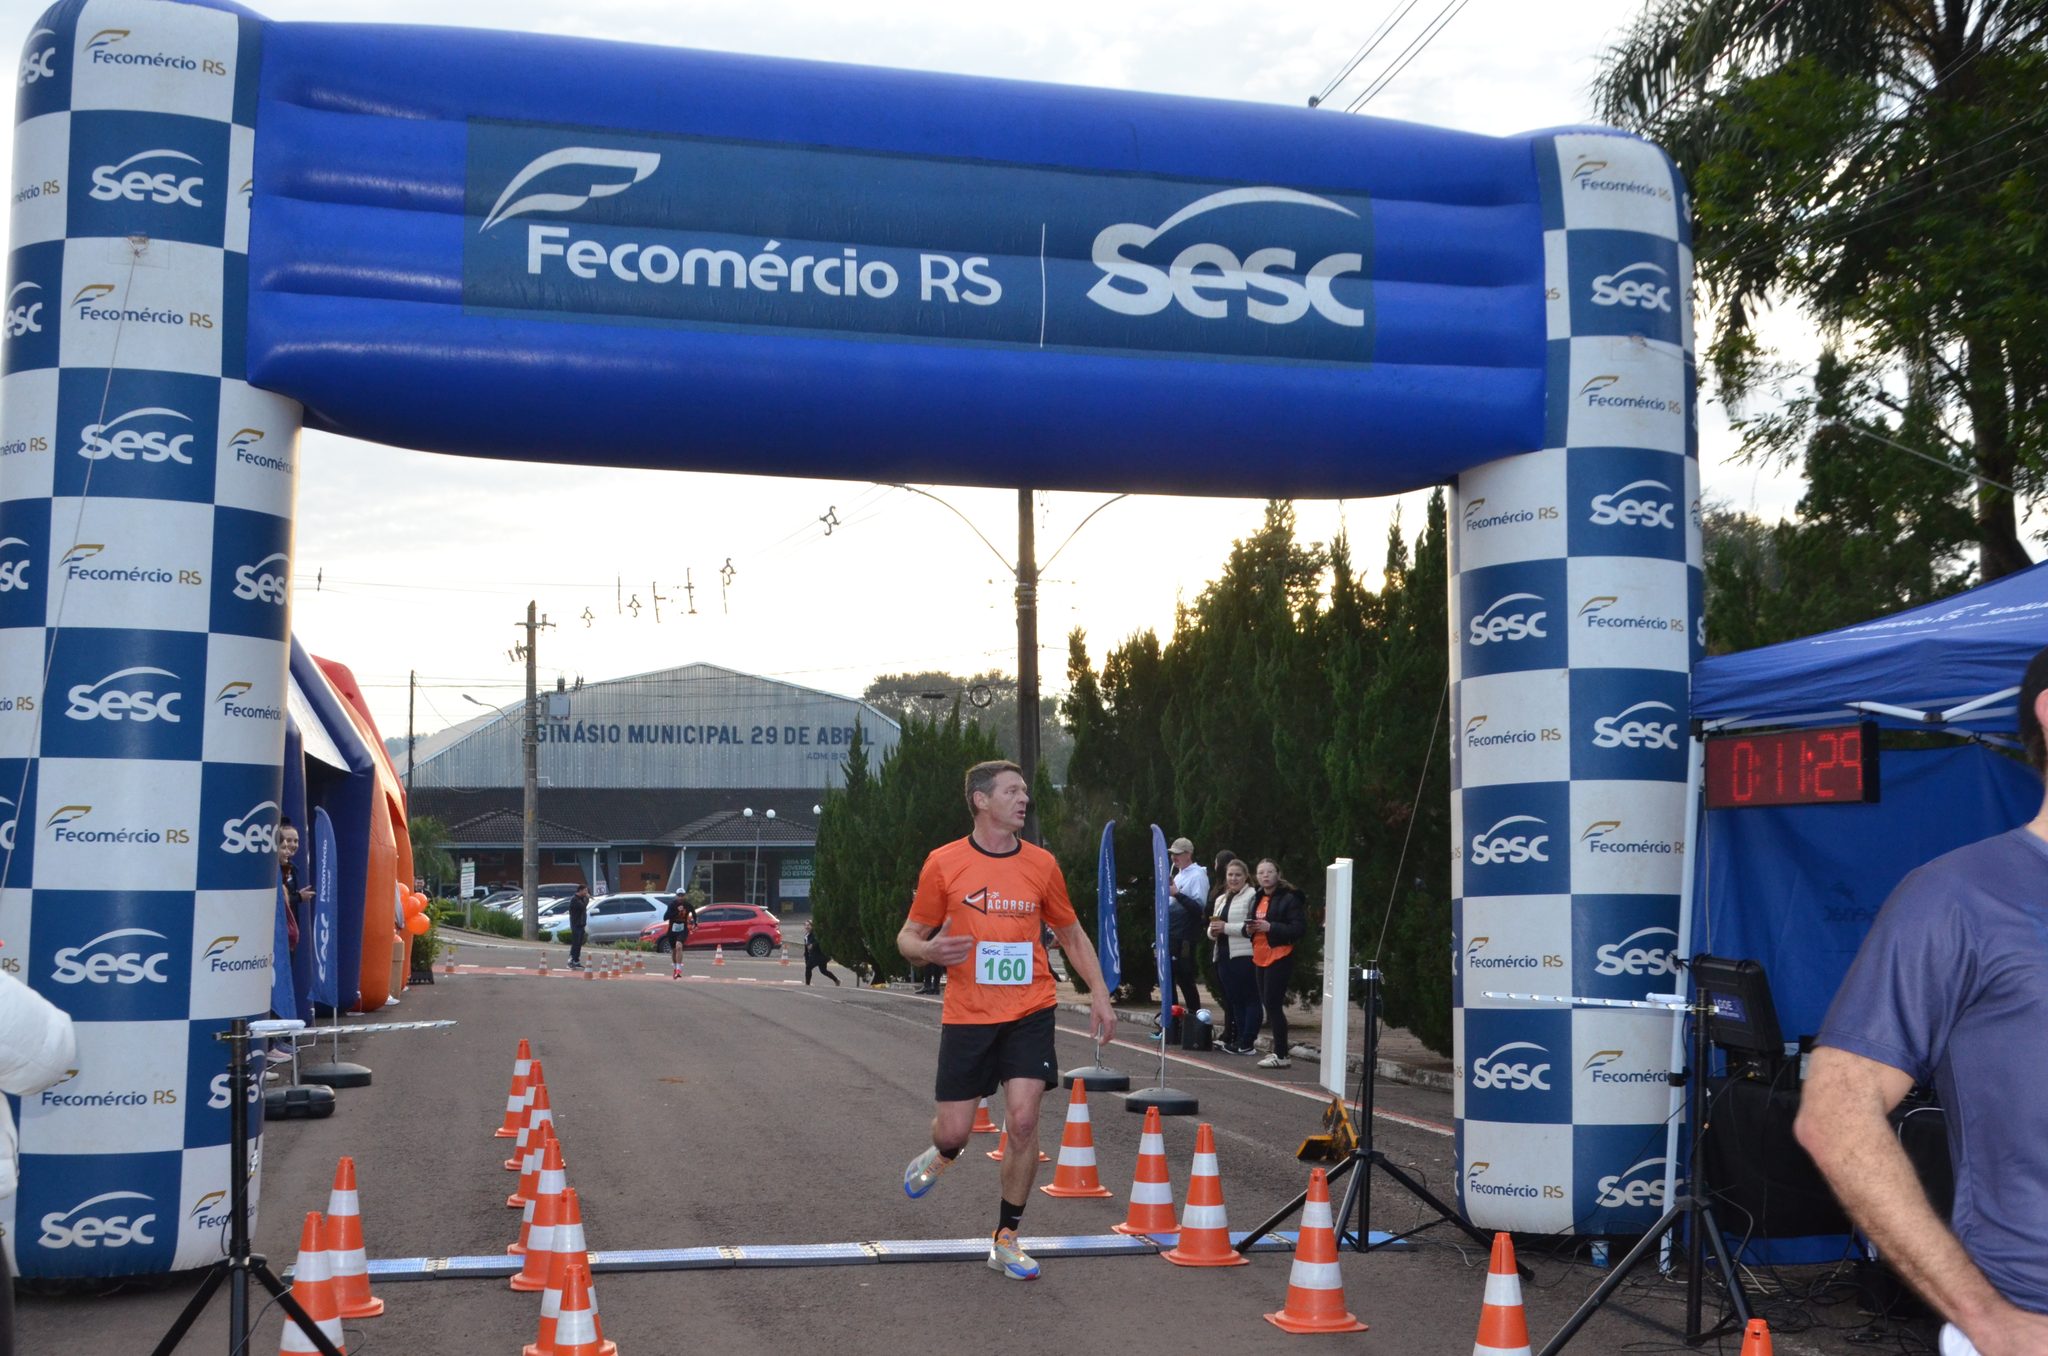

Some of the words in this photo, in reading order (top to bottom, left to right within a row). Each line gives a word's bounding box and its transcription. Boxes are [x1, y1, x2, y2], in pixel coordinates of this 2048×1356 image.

[18, 47, 56, 87] esc
[93, 50, 197, 70] Fecomércio
[202, 59, 227, 76] RS
[43, 180, 61, 195] RS
[89, 165, 204, 208] Sesc
[1581, 179, 1656, 197] Fecomércio
[528, 225, 899, 298] Fecomércio
[921, 253, 1002, 305] RS
[1087, 222, 1365, 327] Sesc
[1591, 274, 1672, 313] Sesc
[5, 301, 43, 340] esc
[80, 306, 183, 325] Fecomércio
[189, 312, 214, 328] RS
[1589, 394, 1665, 412] Fecomércio
[30, 437, 48, 452] RS
[78, 423, 194, 465] Sesc
[1466, 510, 1534, 532] Fecomércio
[1538, 507, 1559, 520] RS
[1589, 494, 1674, 529] Sesc
[0, 560, 30, 592] sc
[69, 566, 172, 583] Fecomércio
[179, 570, 202, 585] RS
[1469, 611, 1547, 646] Sesc
[1588, 615, 1667, 631] Fecomércio
[1670, 619, 1684, 632] RS
[16, 696, 34, 711] RS
[65, 684, 181, 722] Sesc
[537, 721, 620, 743] GINÁSIO
[628, 725, 744, 744] MUNICIPAL
[751, 726, 778, 745] 29
[785, 726, 810, 745] DE
[1468, 731, 1536, 748] Fecomércio
[1541, 728, 1561, 742] RS
[1592, 716, 1678, 749] Sesc
[55, 828, 160, 843] Fecomércio
[166, 829, 190, 844] RS
[1591, 839, 1671, 854] Fecomércio
[1472, 833, 1549, 865] Sesc
[2, 958, 20, 973] RS
[51, 946, 169, 984] Sesc
[984, 958, 1026, 981] 160
[1470, 954, 1538, 969] Fecomércio
[1543, 955, 1564, 968] RS
[1472, 1056, 1551, 1091] Sesc
[41, 1090, 147, 1106] Fecomércio
[153, 1089, 177, 1104] RS
[1471, 1183, 1538, 1198] Fecomércio
[1543, 1184, 1564, 1199] RS
[37, 1211, 156, 1250] Sesc
